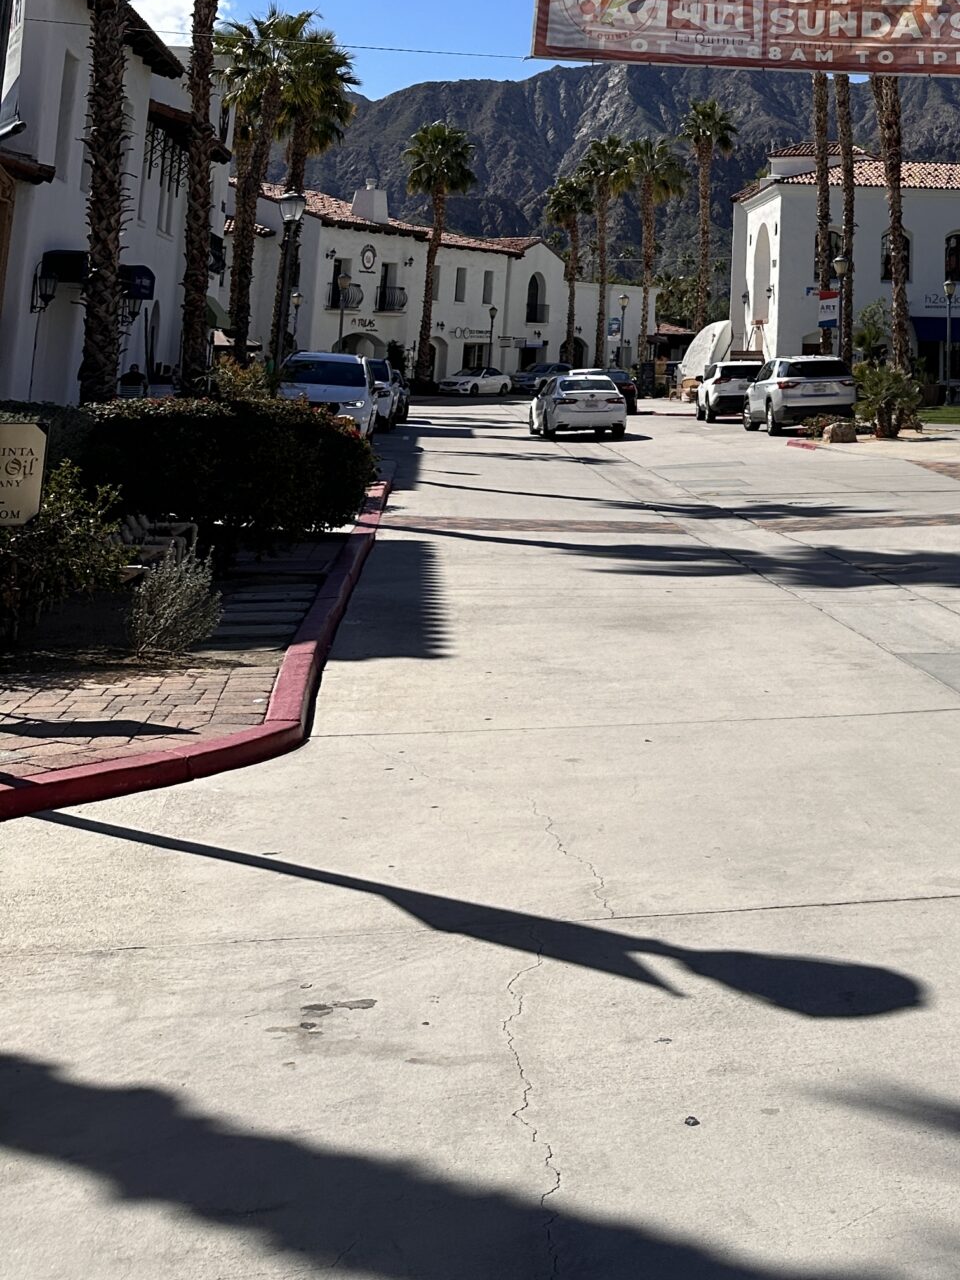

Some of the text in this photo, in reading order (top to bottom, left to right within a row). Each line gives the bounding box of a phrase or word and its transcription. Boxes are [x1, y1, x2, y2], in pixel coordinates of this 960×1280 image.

[597, 32, 635, 41] QUINTA
[674, 31, 744, 48] La Quinta
[768, 46, 833, 63] 8AM
[856, 50, 894, 64] TO
[924, 293, 947, 305] h2o
[5, 458, 38, 478] Oil
